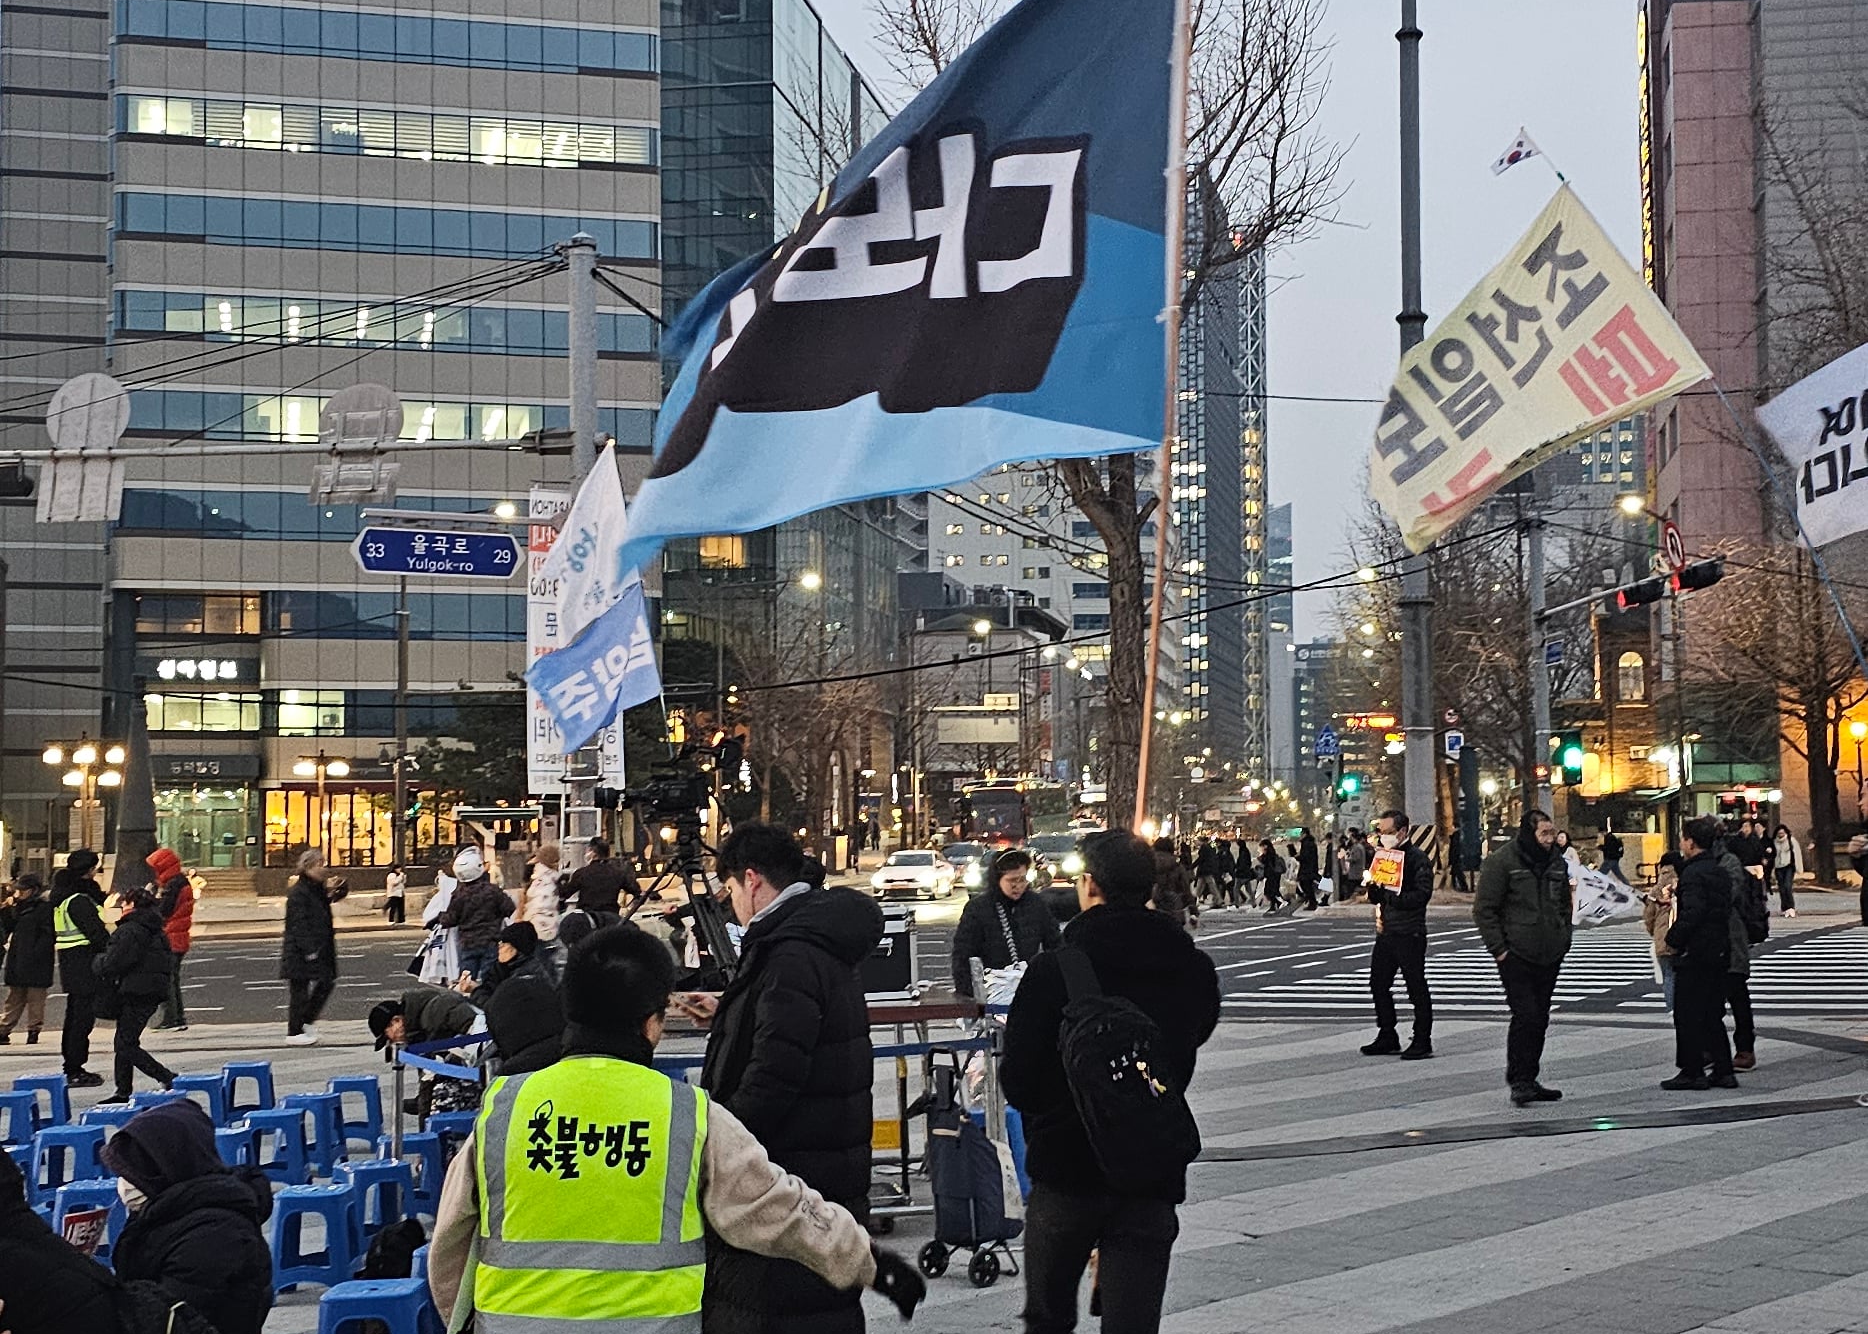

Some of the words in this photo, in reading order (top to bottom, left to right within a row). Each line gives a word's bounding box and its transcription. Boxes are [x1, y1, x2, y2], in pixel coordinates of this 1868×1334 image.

[365, 543, 385, 558] 33
[410, 534, 470, 556] 율곡로
[493, 549, 511, 564] 29
[406, 557, 474, 572] Yulgok-ro
[526, 1109, 652, 1180] 촛불행동
